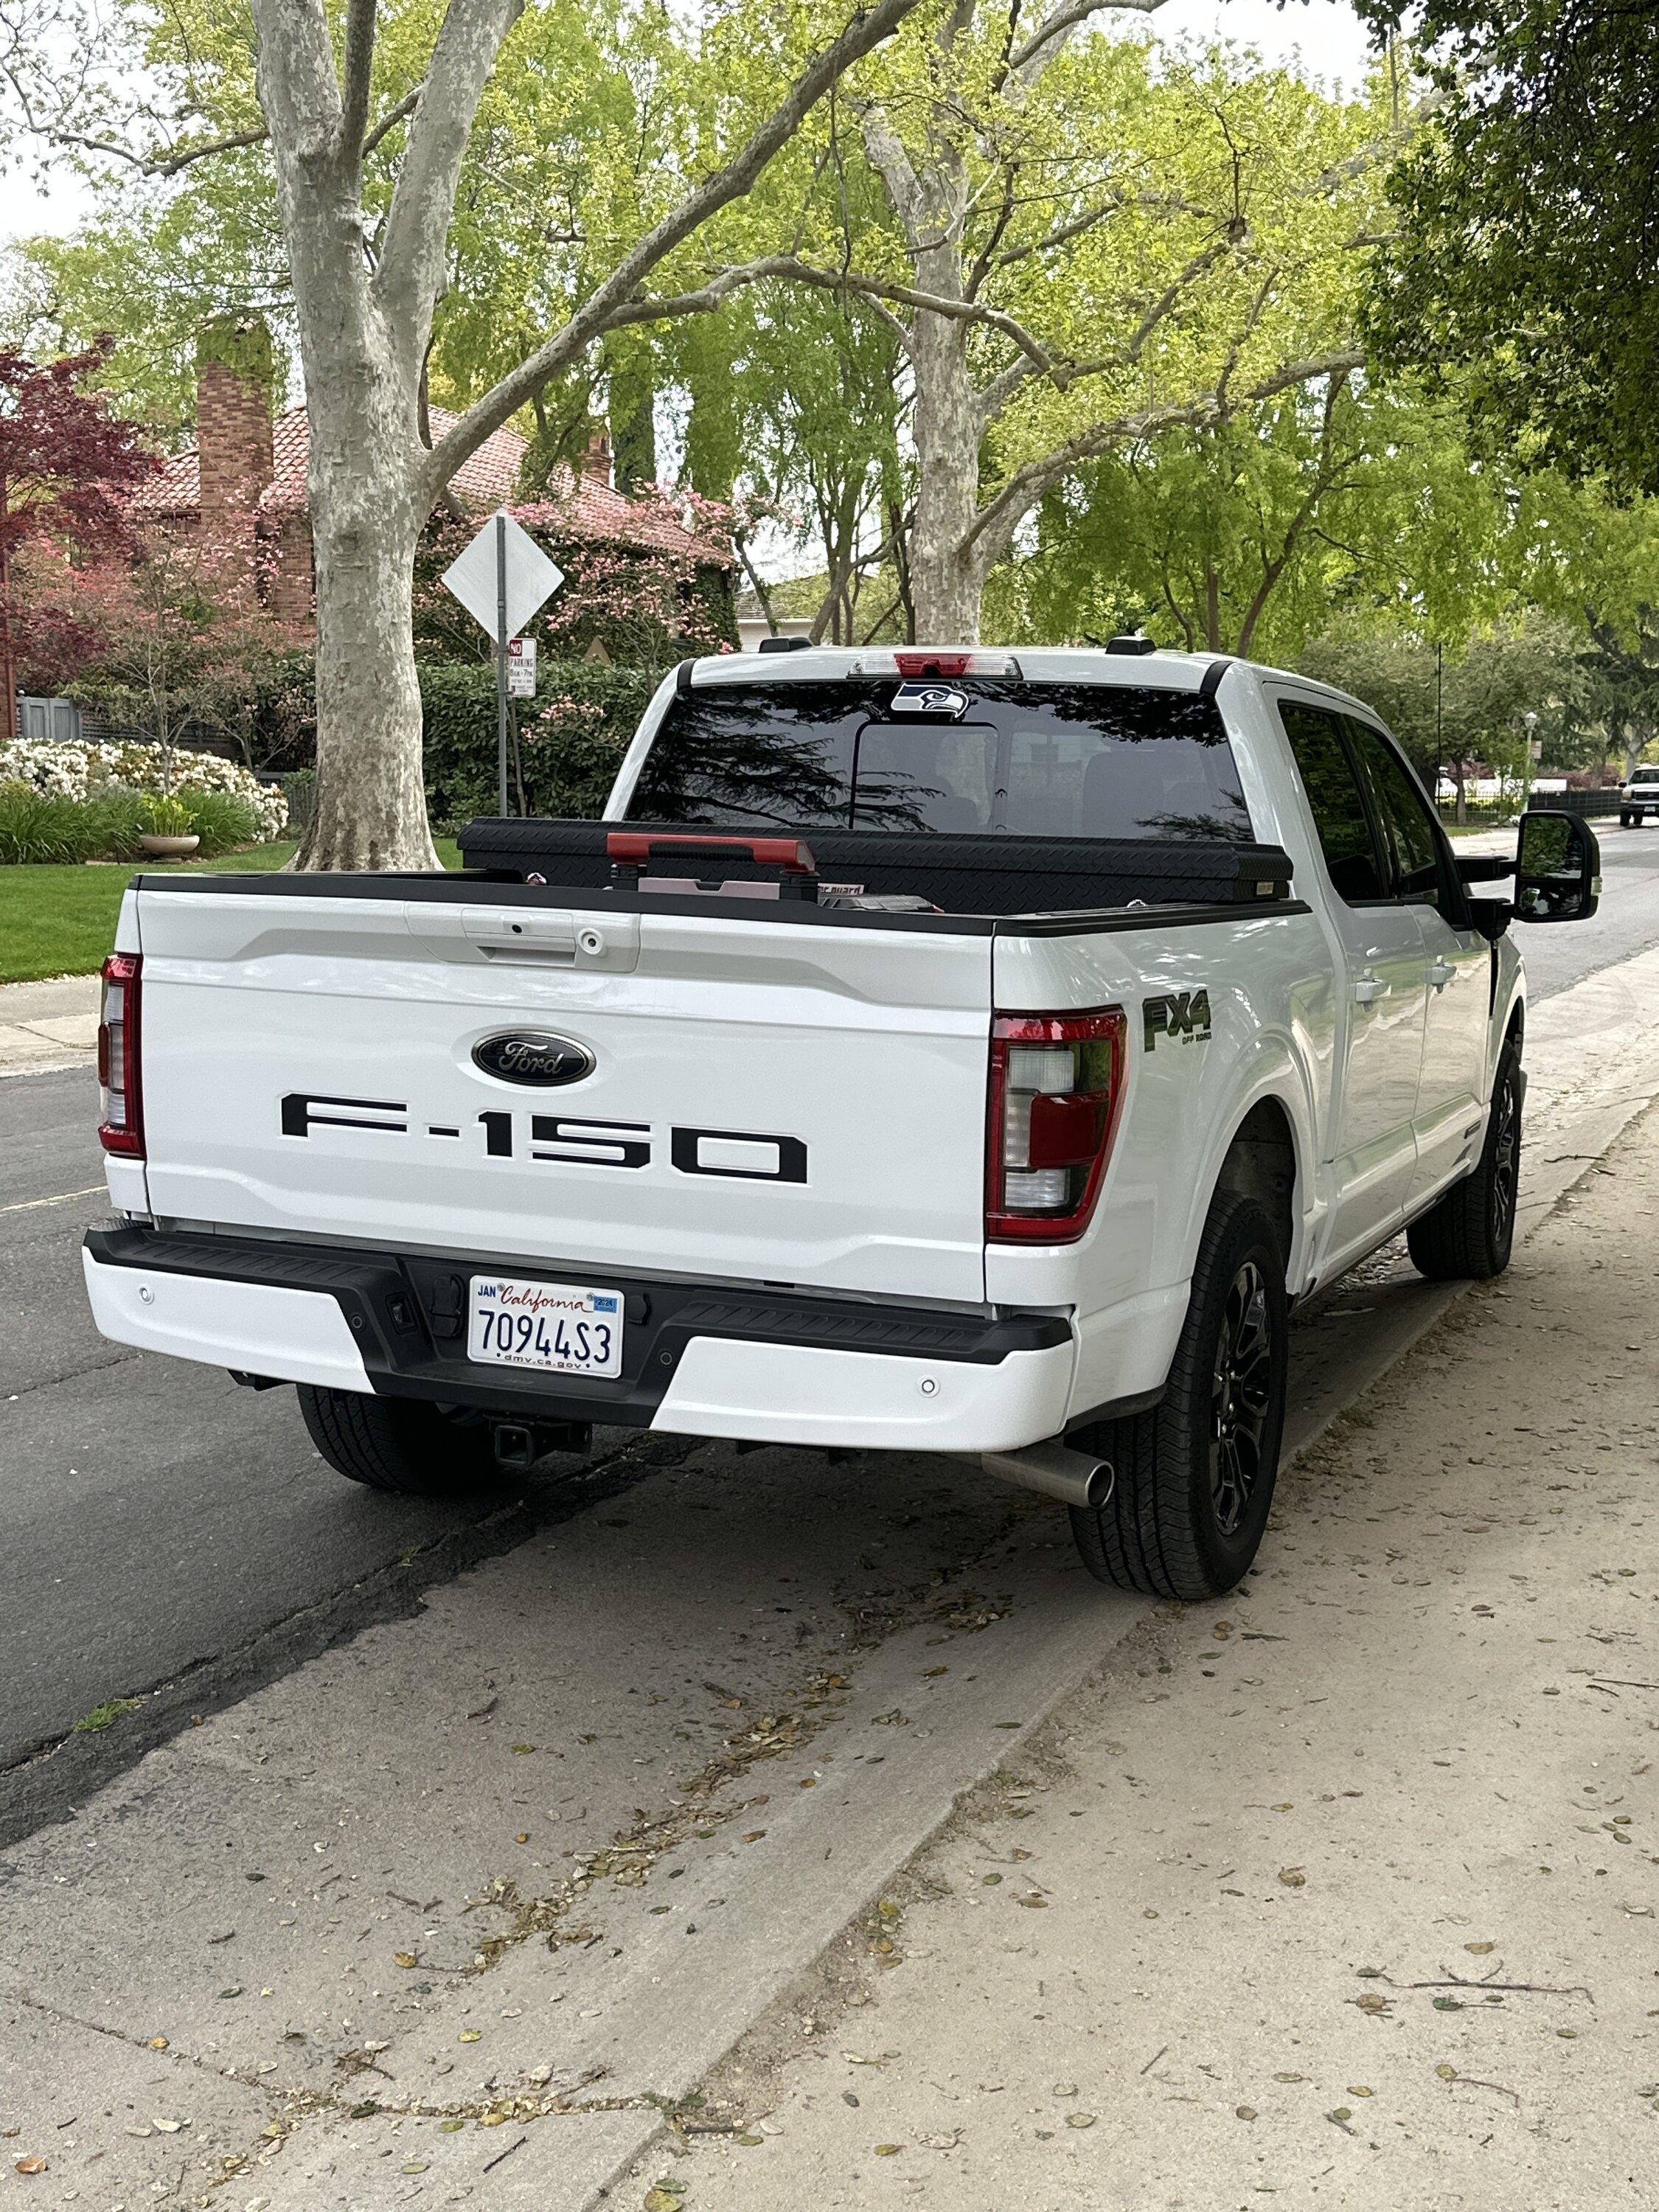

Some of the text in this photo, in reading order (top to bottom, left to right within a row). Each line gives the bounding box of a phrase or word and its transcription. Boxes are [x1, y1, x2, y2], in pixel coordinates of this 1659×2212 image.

[510, 643, 521, 654] NO
[509, 658, 533, 667] PARKING
[1142, 989, 1211, 1052] FX4
[1182, 1035, 1194, 1045] OFF
[498, 1041, 564, 1074] Ford
[281, 1092, 807, 1183] F-150
[478, 1284, 496, 1298] JAN
[500, 1285, 594, 1313] California
[479, 1309, 611, 1363] 70944S3
[504, 1354, 582, 1369] dmv.ca.gov
